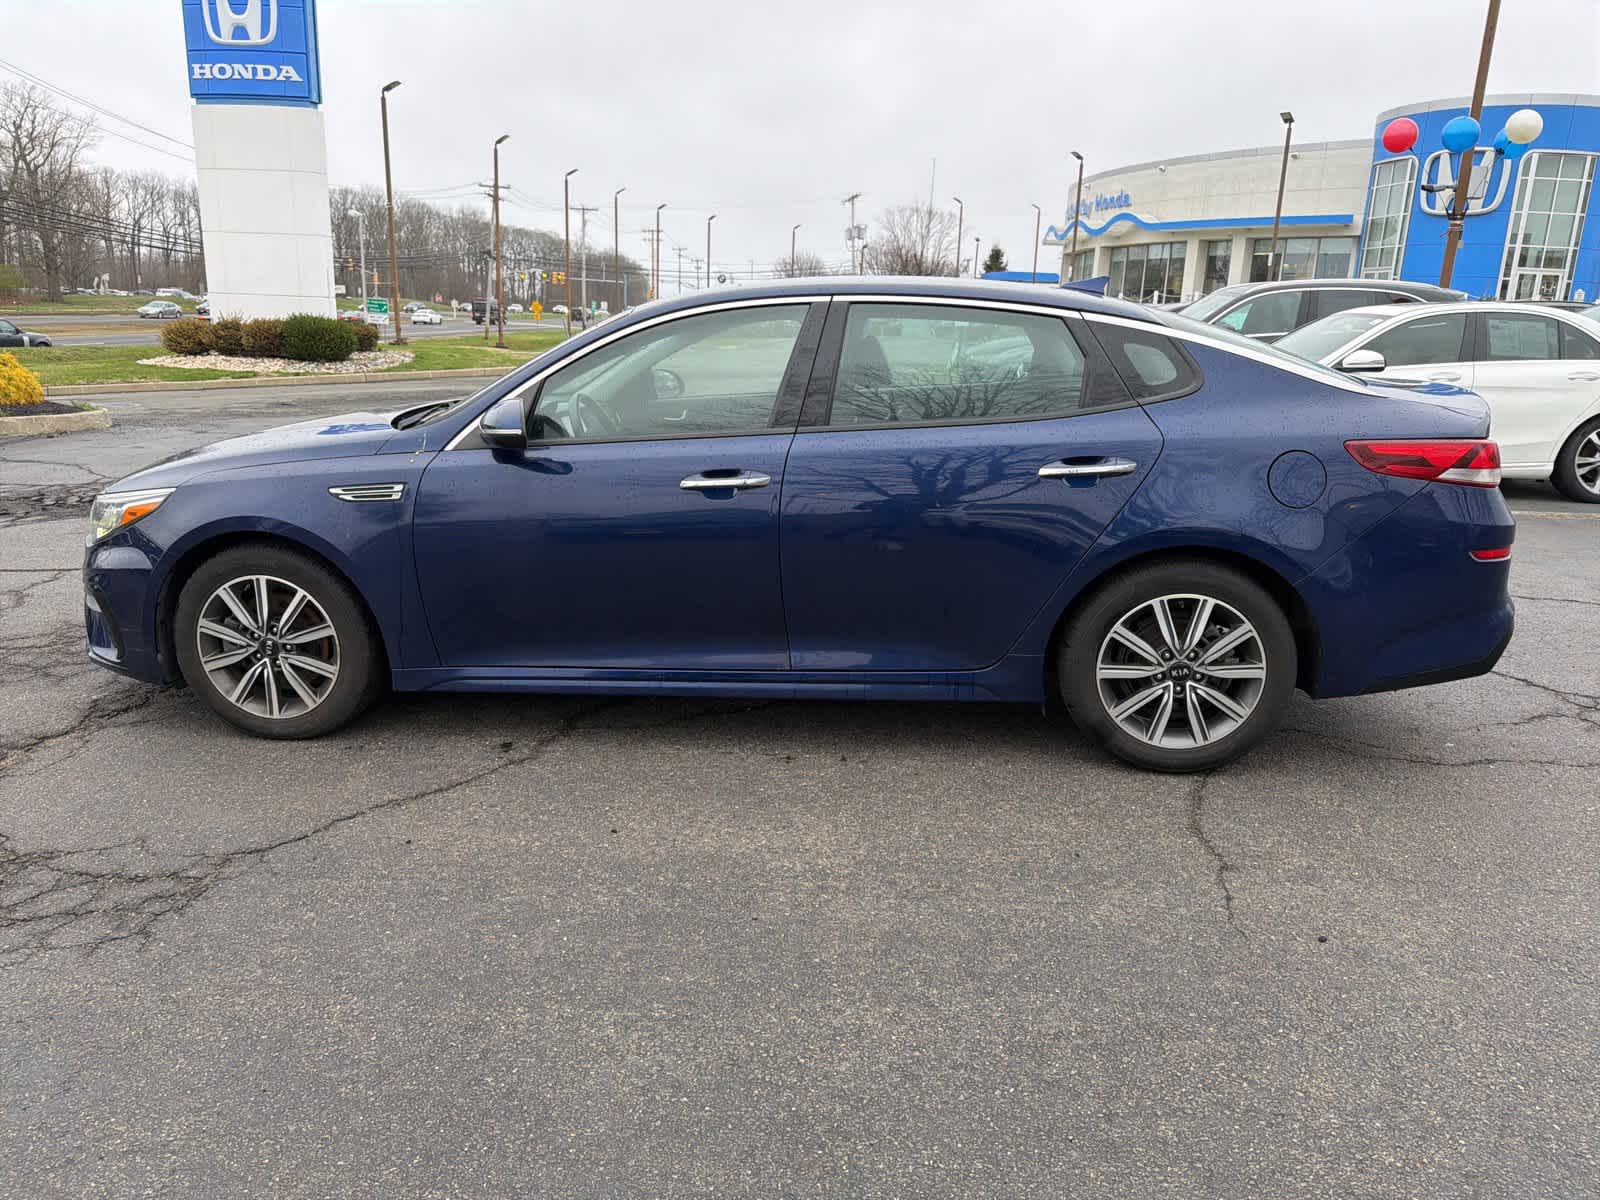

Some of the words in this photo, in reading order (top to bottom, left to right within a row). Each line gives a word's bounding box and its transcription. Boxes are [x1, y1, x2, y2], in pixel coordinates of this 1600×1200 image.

[191, 63, 304, 82] HONDA
[1094, 190, 1132, 211] Honda
[1170, 668, 1190, 678] KIA
